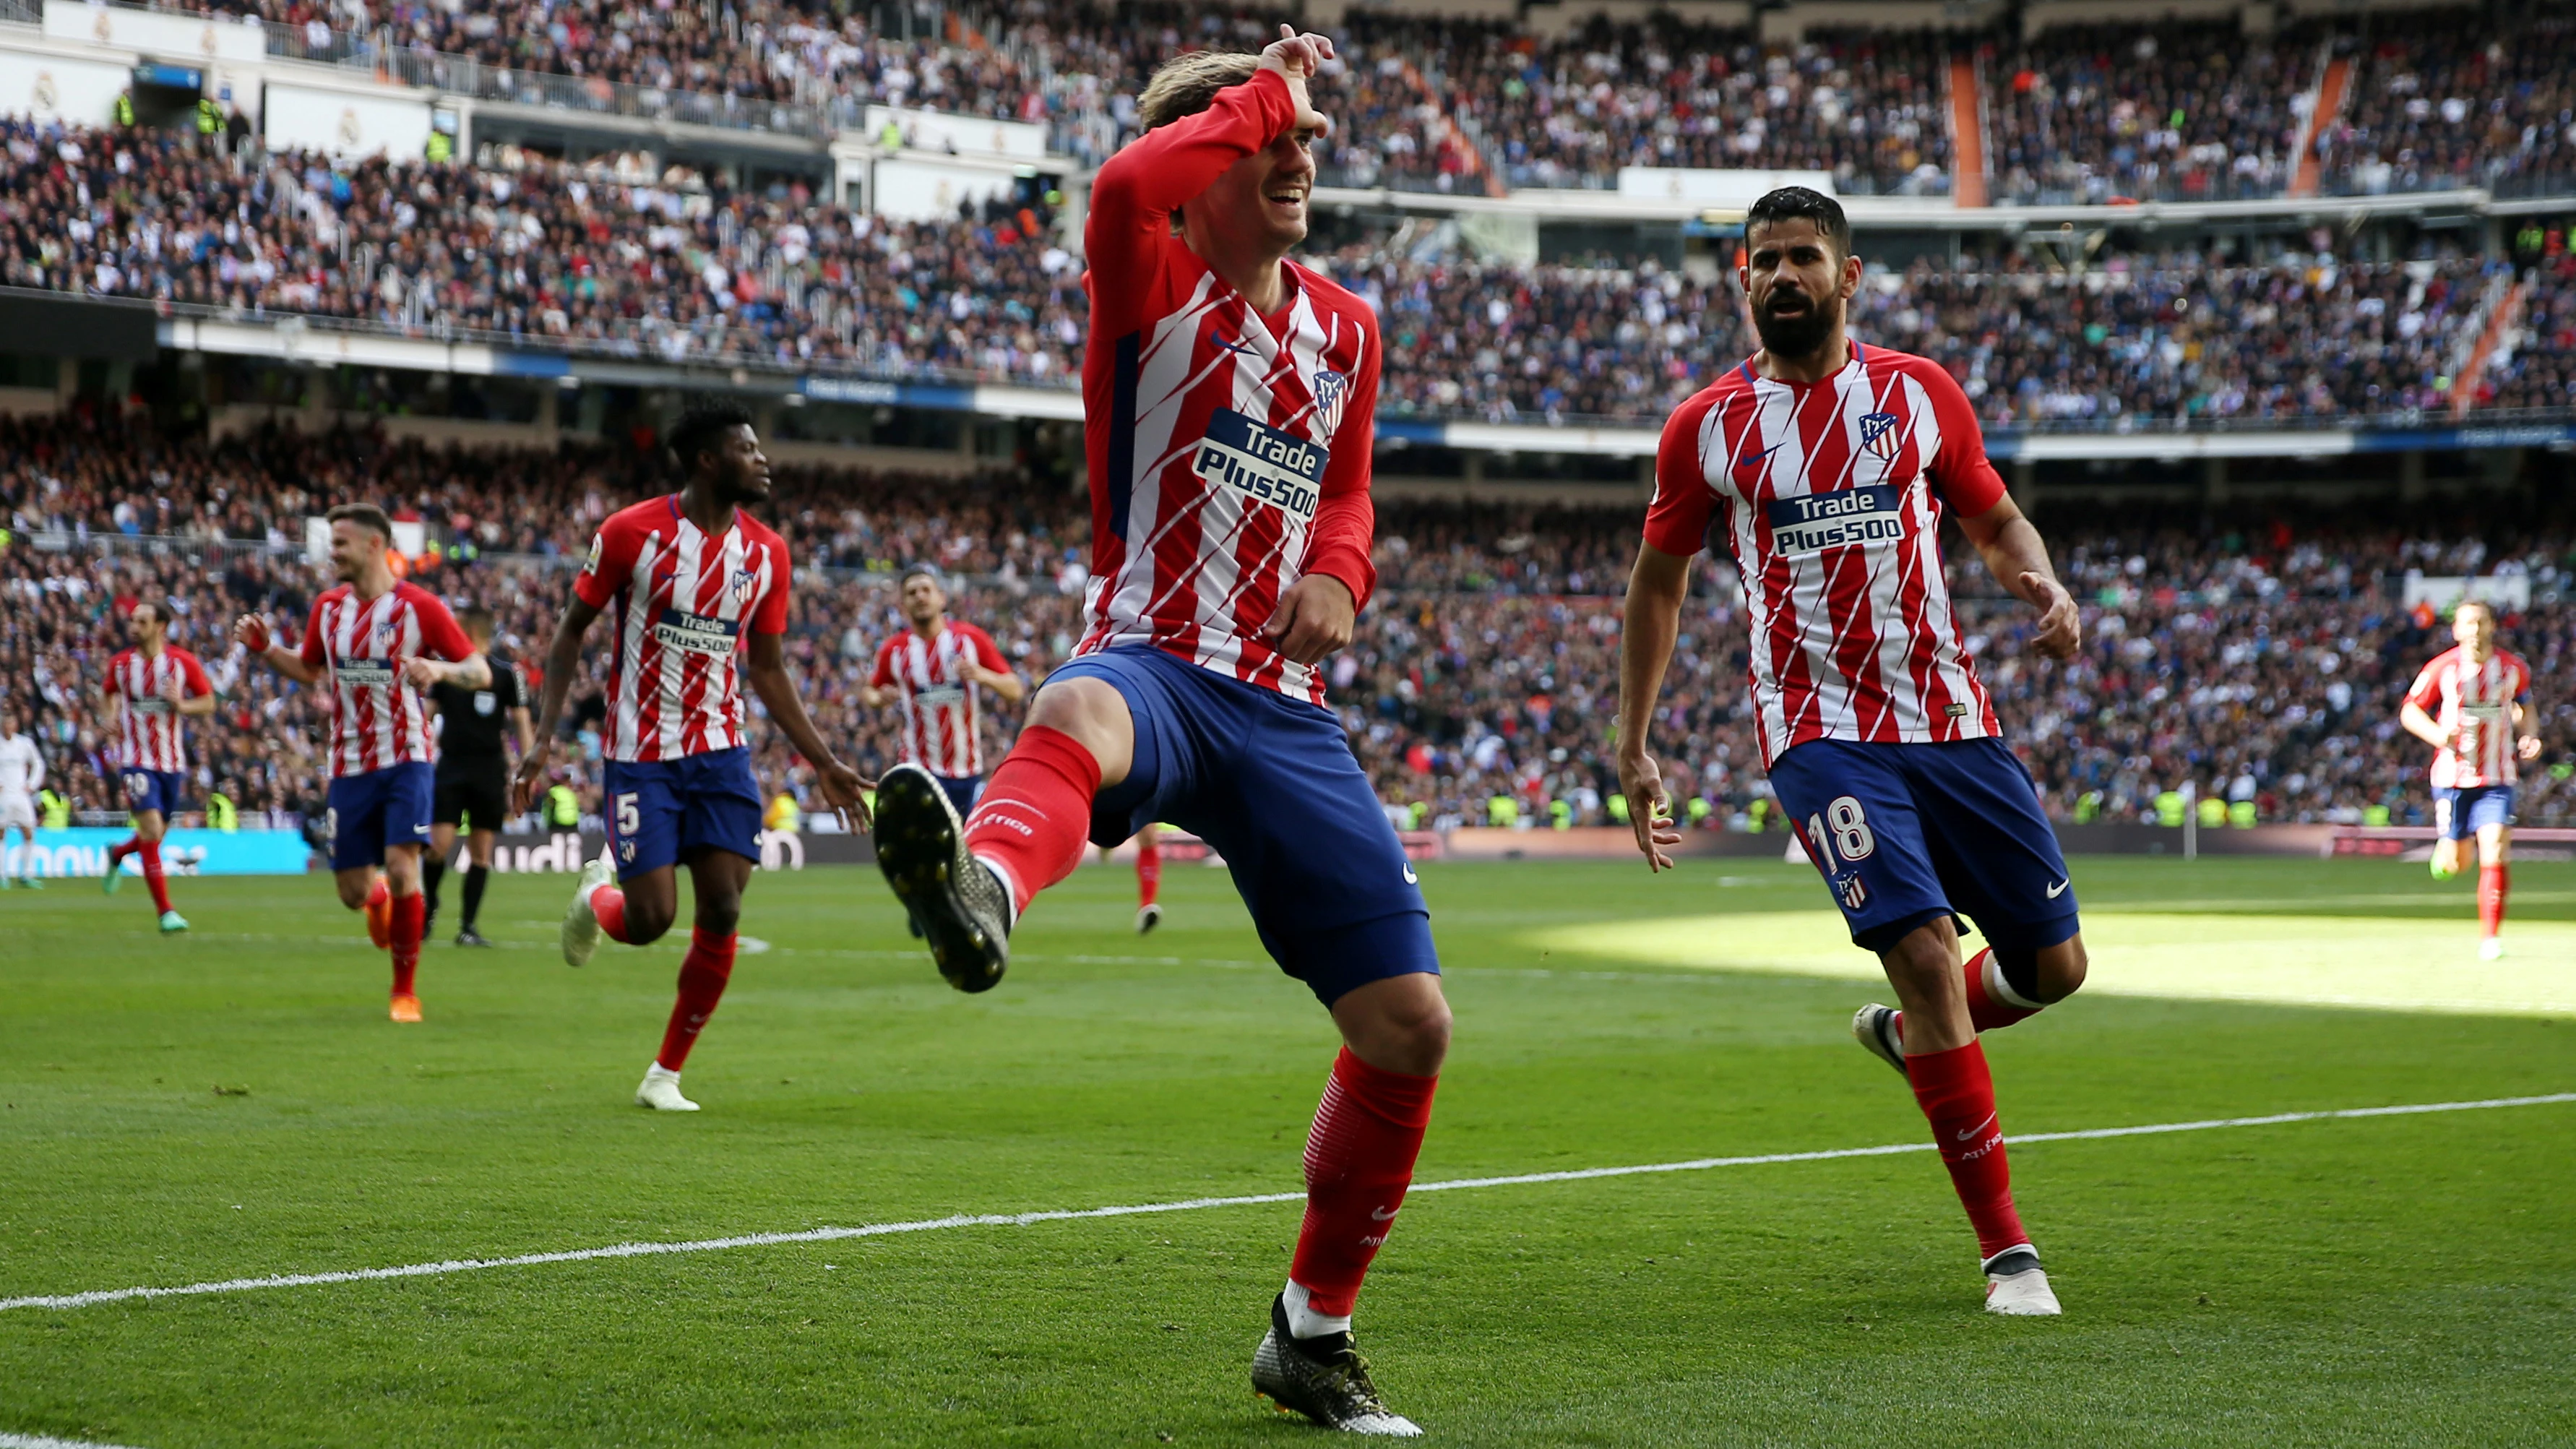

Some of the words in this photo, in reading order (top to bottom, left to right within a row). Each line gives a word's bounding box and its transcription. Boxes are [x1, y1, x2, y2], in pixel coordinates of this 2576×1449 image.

[1246, 422, 1317, 476] Trade
[1197, 446, 1317, 518] Plus500
[1795, 490, 1875, 520] Trade
[1776, 519, 1902, 555] Plus500
[658, 627, 733, 652] Plus500
[681, 613, 726, 634] Trade
[616, 792, 639, 836] 5
[1808, 796, 1874, 876] 18
